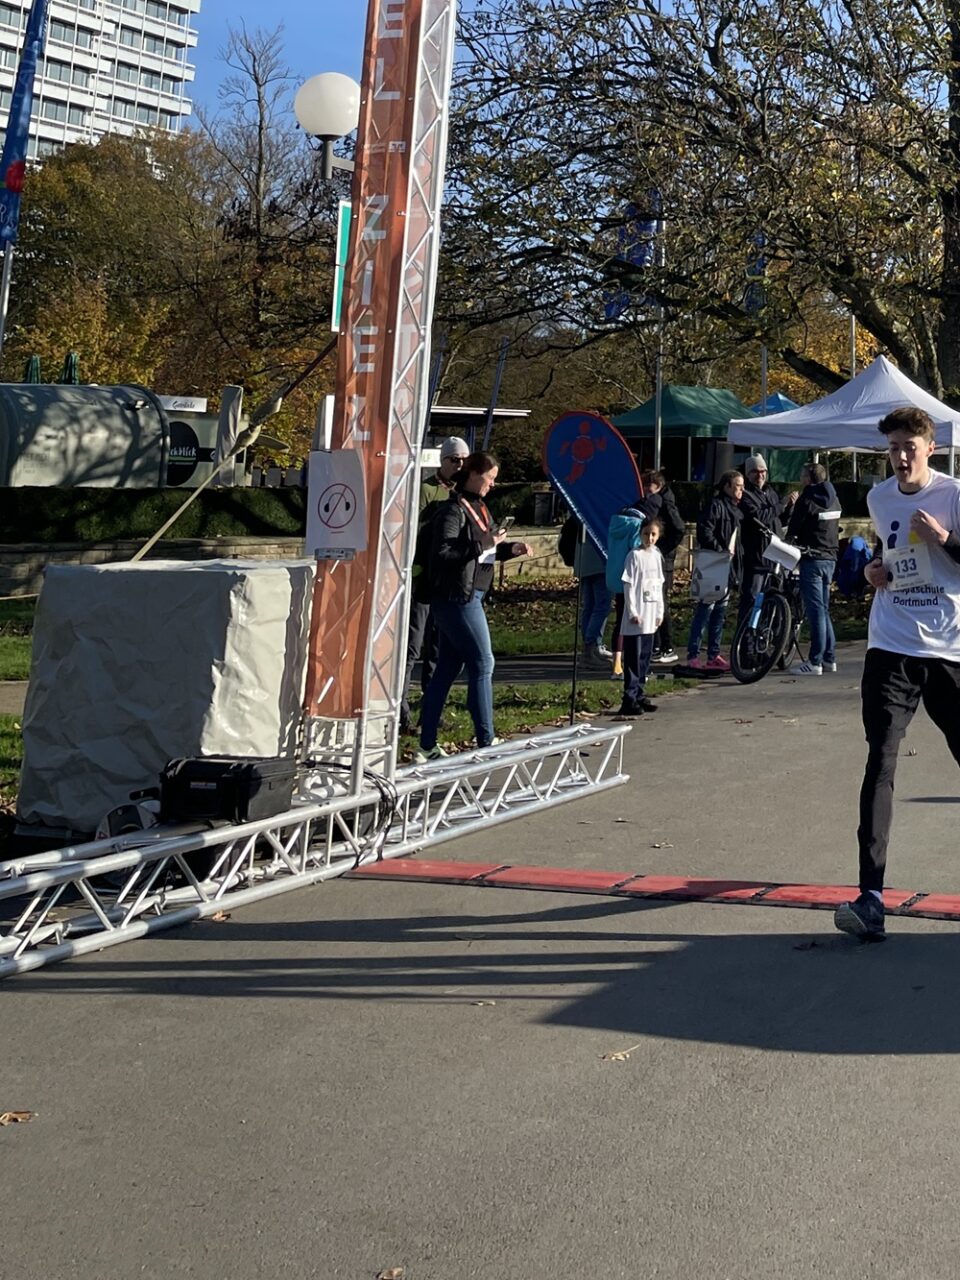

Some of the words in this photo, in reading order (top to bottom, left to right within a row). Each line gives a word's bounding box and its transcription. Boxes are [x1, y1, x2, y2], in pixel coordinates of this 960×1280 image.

[353, 194, 390, 441] ZIEL
[895, 558, 917, 573] 133
[893, 584, 945, 595] paschule
[893, 595, 939, 607] Dortmund
